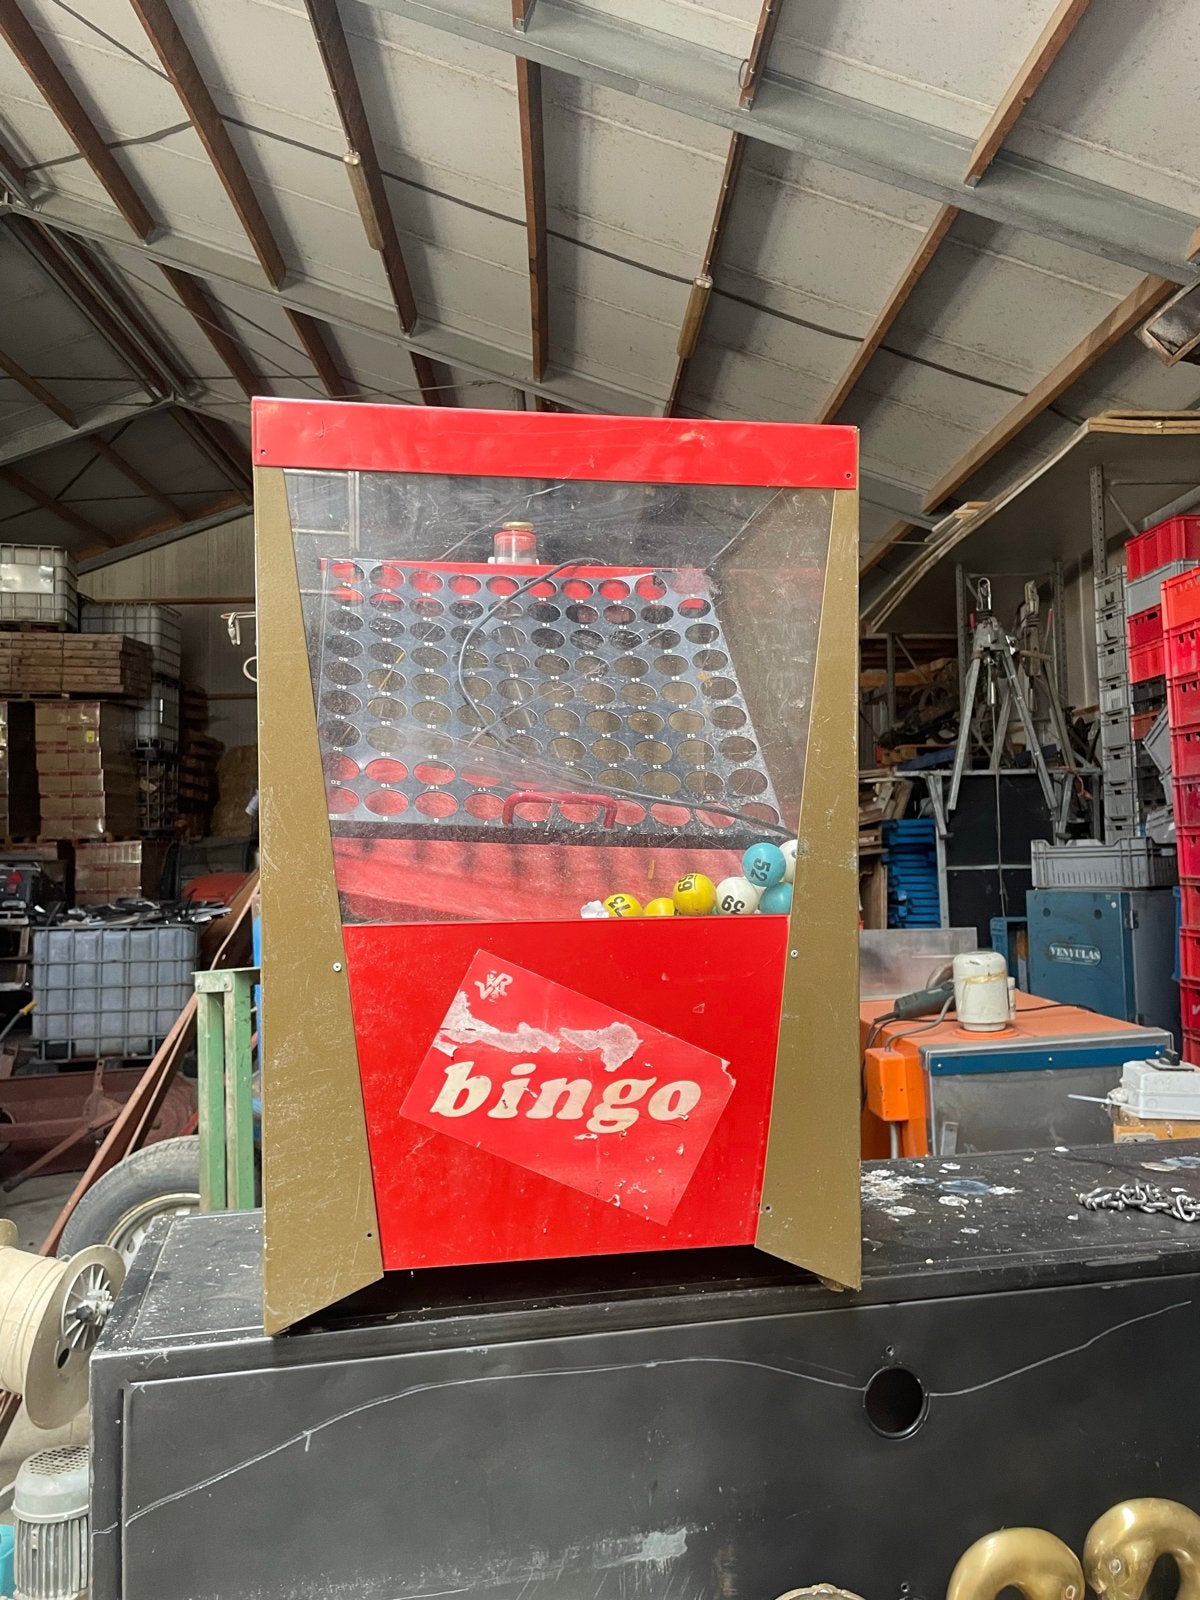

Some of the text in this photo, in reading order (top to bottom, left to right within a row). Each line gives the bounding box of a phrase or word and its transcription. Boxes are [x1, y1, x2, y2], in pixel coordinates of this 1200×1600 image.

[750, 858, 771, 882] 52
[608, 896, 631, 917] 73
[721, 895, 745, 914] 39
[430, 1061, 701, 1133] bingo
